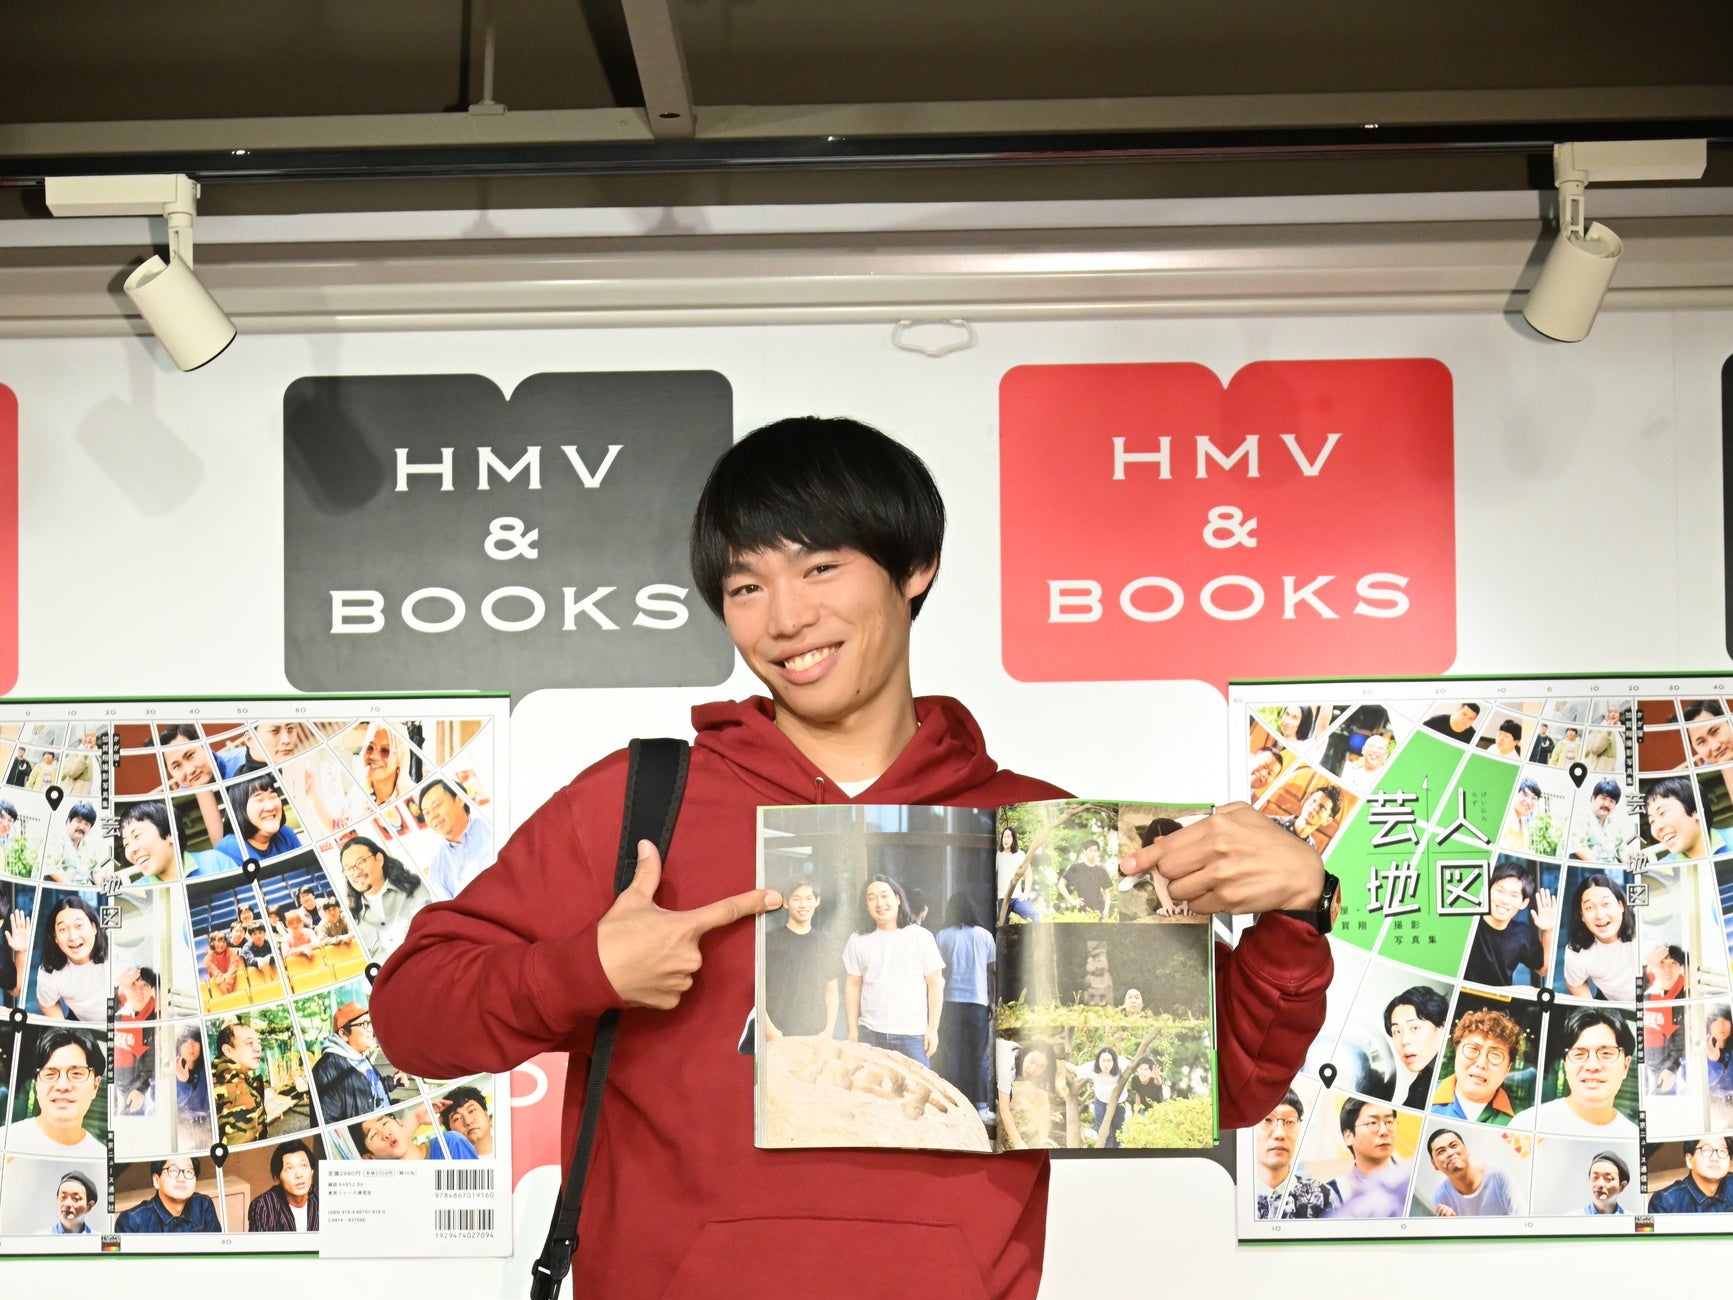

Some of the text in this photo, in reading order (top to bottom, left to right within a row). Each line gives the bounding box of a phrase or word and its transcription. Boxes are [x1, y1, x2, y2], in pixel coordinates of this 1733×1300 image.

[394, 444, 625, 491] HMV
[1111, 433, 1344, 480] HMV
[484, 516, 538, 560] &
[1203, 505, 1257, 549] &
[329, 583, 689, 634] BOOKS
[1046, 572, 1410, 623] BOOKS
[1366, 787, 1491, 848] 芸人
[101, 815, 122, 928] 芸人地図
[1625, 793, 1649, 906] 芸人地図
[1366, 860, 1491, 918] 地図
[1394, 935, 1437, 945] 写真集
